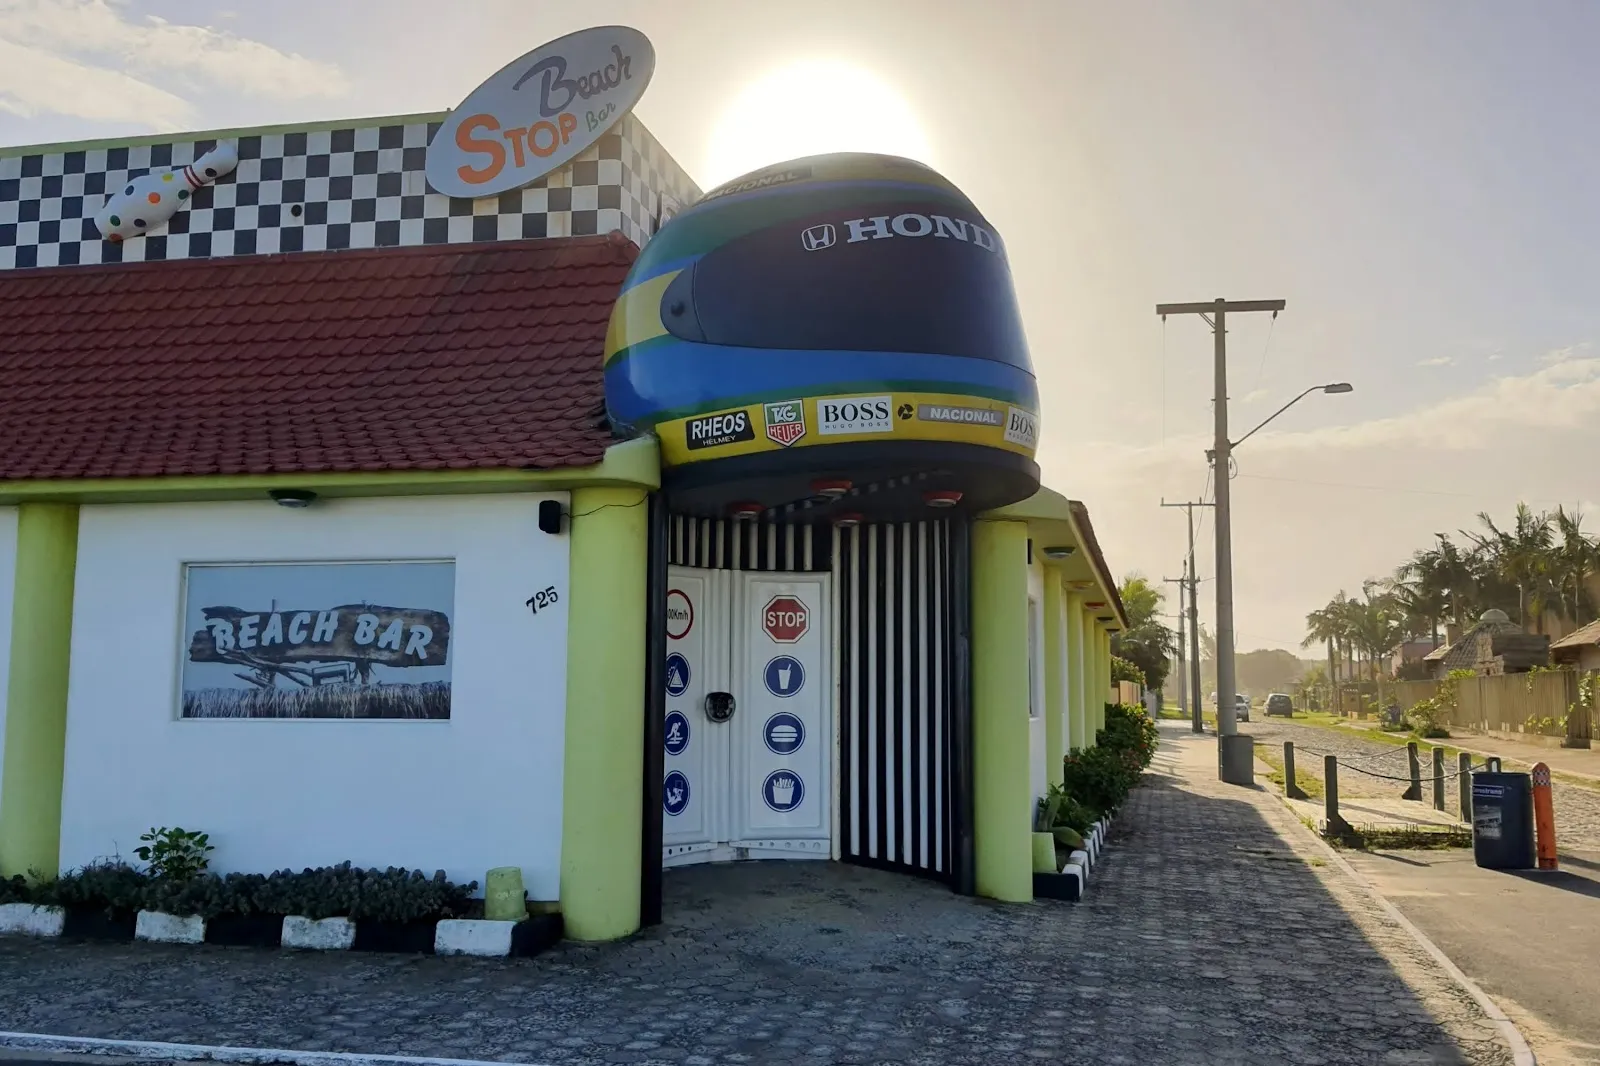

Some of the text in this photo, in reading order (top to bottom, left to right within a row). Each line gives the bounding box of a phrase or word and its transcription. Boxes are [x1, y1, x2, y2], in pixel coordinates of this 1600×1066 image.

[512, 44, 632, 118] Beach
[455, 101, 616, 184] STOP Bar
[844, 213, 998, 253] HOND
[692, 412, 746, 441] RHEOS
[771, 405, 797, 423] TAG
[824, 401, 889, 423] BOSS
[930, 407, 997, 424] NACIONAL
[768, 424, 802, 443] HEUER
[525, 585, 559, 615] 725
[767, 611, 806, 628] STOP
[205, 611, 434, 660] BEACH BAR
